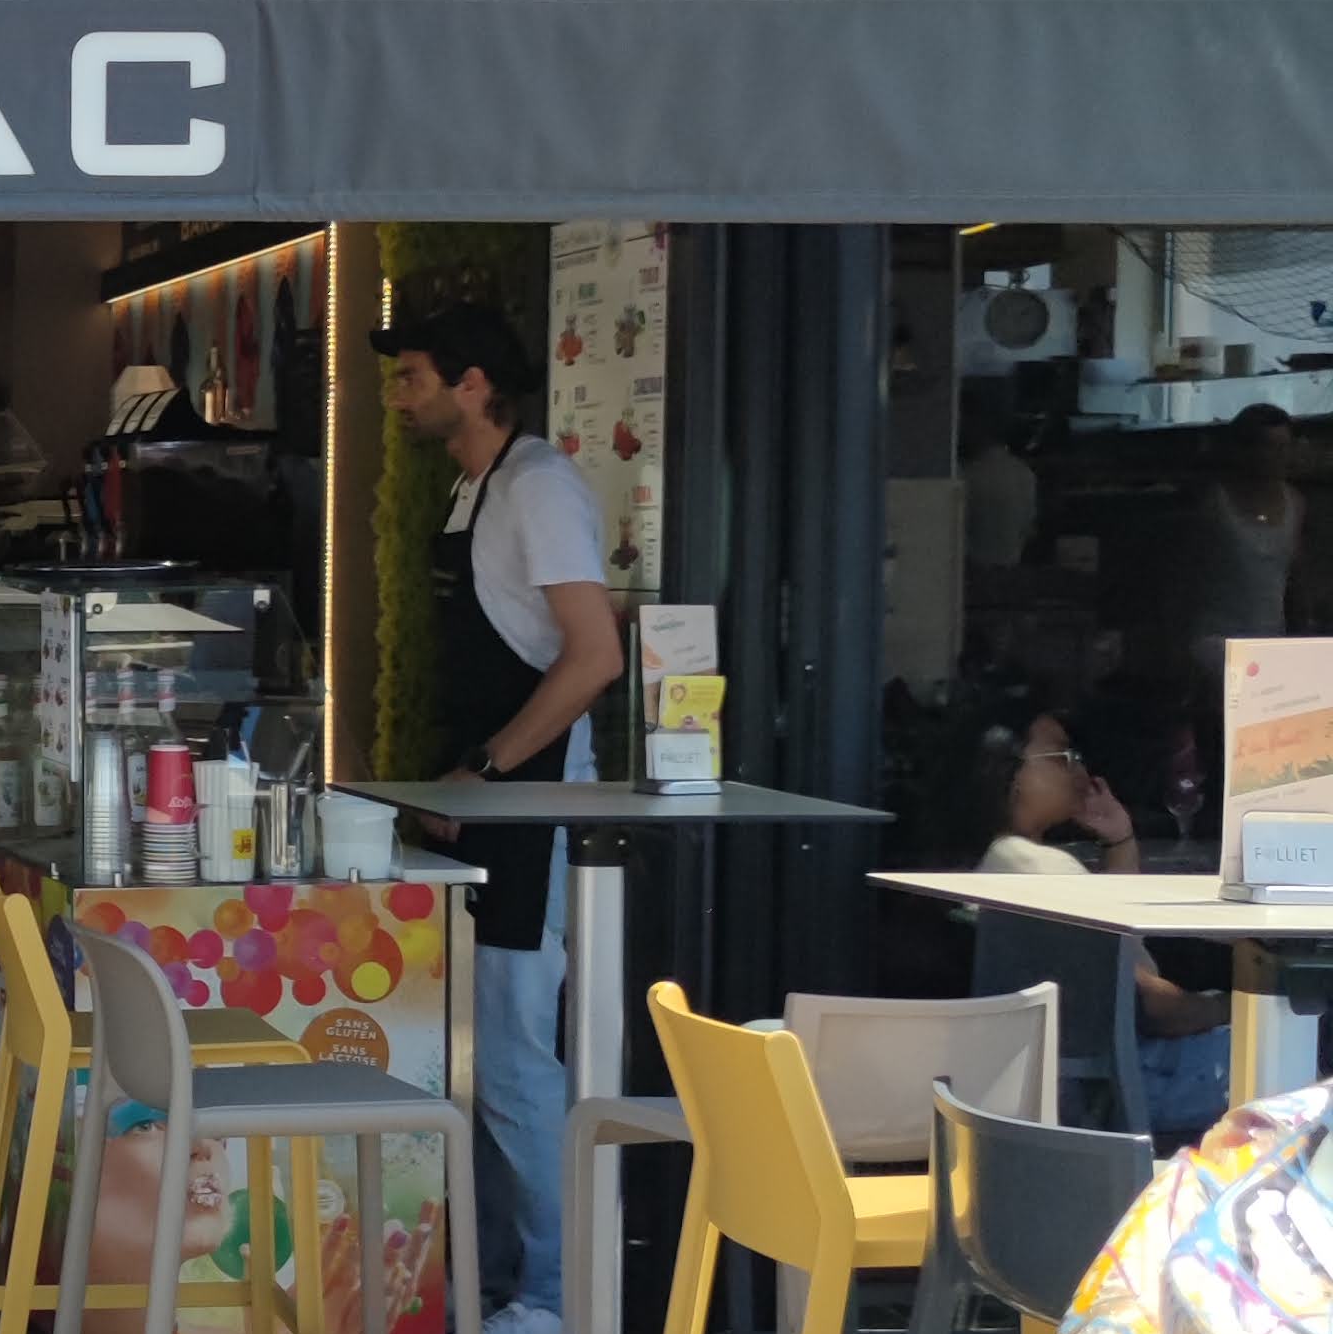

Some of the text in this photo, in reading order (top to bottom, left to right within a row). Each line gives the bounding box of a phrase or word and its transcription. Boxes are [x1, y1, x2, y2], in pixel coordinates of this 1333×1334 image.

[335, 1018, 370, 1031] SANS
[325, 1026, 377, 1040] GLUTEN
[332, 1043, 367, 1055] SANS
[318, 1052, 379, 1066] LACTOSE
